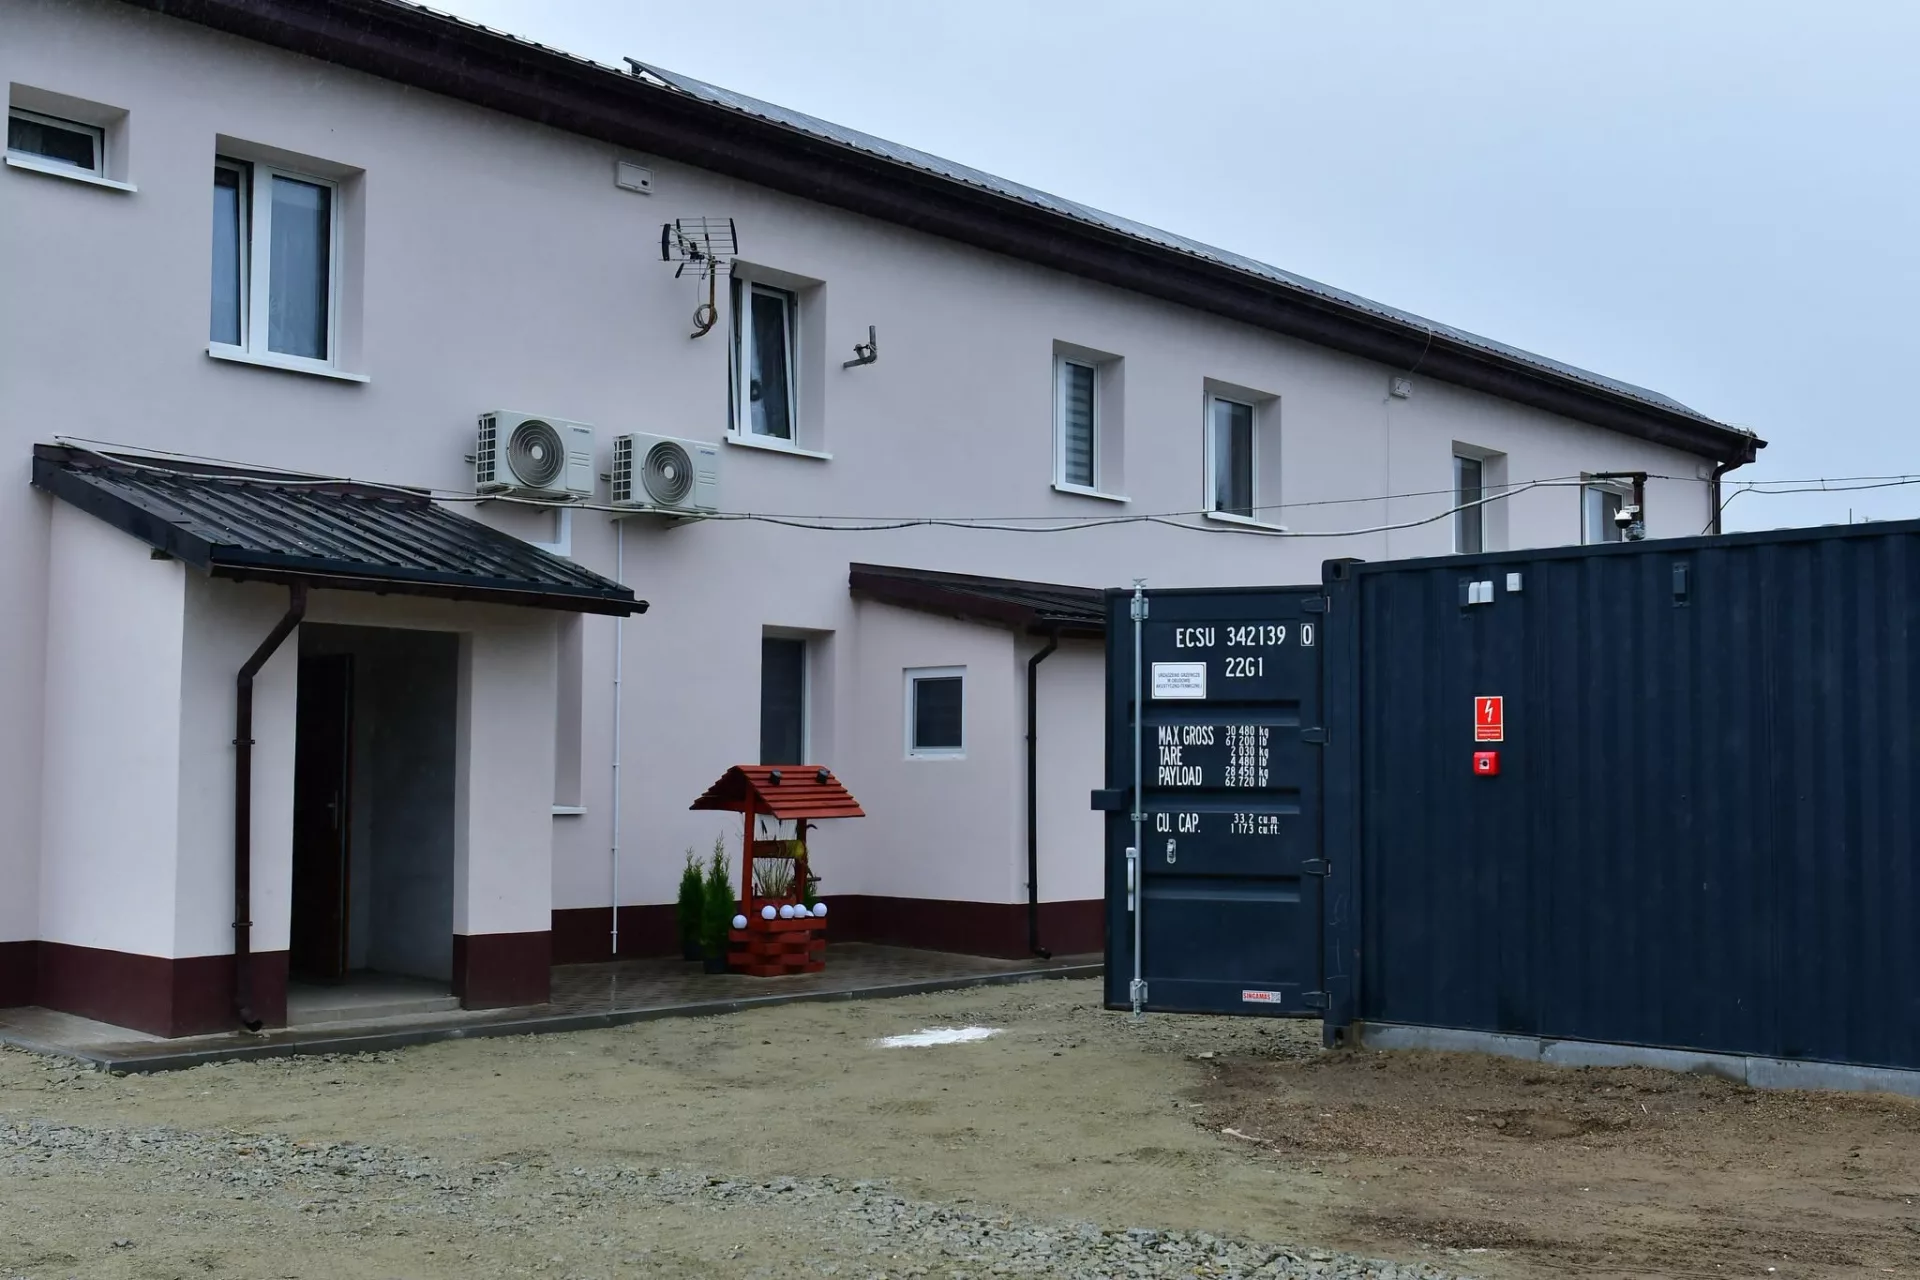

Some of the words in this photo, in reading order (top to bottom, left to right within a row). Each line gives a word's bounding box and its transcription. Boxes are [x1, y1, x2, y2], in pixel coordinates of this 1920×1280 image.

[1175, 627, 1215, 648] ECSU
[1226, 625, 1287, 647] 342139
[1302, 625, 1313, 645] 0
[1225, 656, 1263, 678] 22G1
[1158, 726, 1180, 746] MAX
[1183, 726, 1215, 746] GROSS
[1226, 726, 1236, 736] 30
[1239, 726, 1255, 736] 480
[1259, 726, 1269, 738] kg
[1226, 736, 1236, 746] 67
[1239, 736, 1255, 746] 200
[1259, 736, 1268, 746] lb
[1159, 746, 1183, 766] TARE
[1231, 746, 1237, 756] 2
[1239, 746, 1255, 756] 030
[1259, 747, 1269, 758] kg
[1230, 757, 1237, 766] 4
[1239, 757, 1255, 766] 480
[1259, 757, 1268, 766] lb
[1158, 766, 1203, 786] PAYLOAD
[1225, 767, 1236, 777] 28
[1239, 767, 1255, 777] 450
[1259, 767, 1269, 779] kg
[1225, 777, 1236, 787] 62
[1239, 777, 1255, 787] 720
[1259, 777, 1268, 787] lb
[1157, 813, 1172, 833] CU.
[1178, 813, 1201, 833] CAP.
